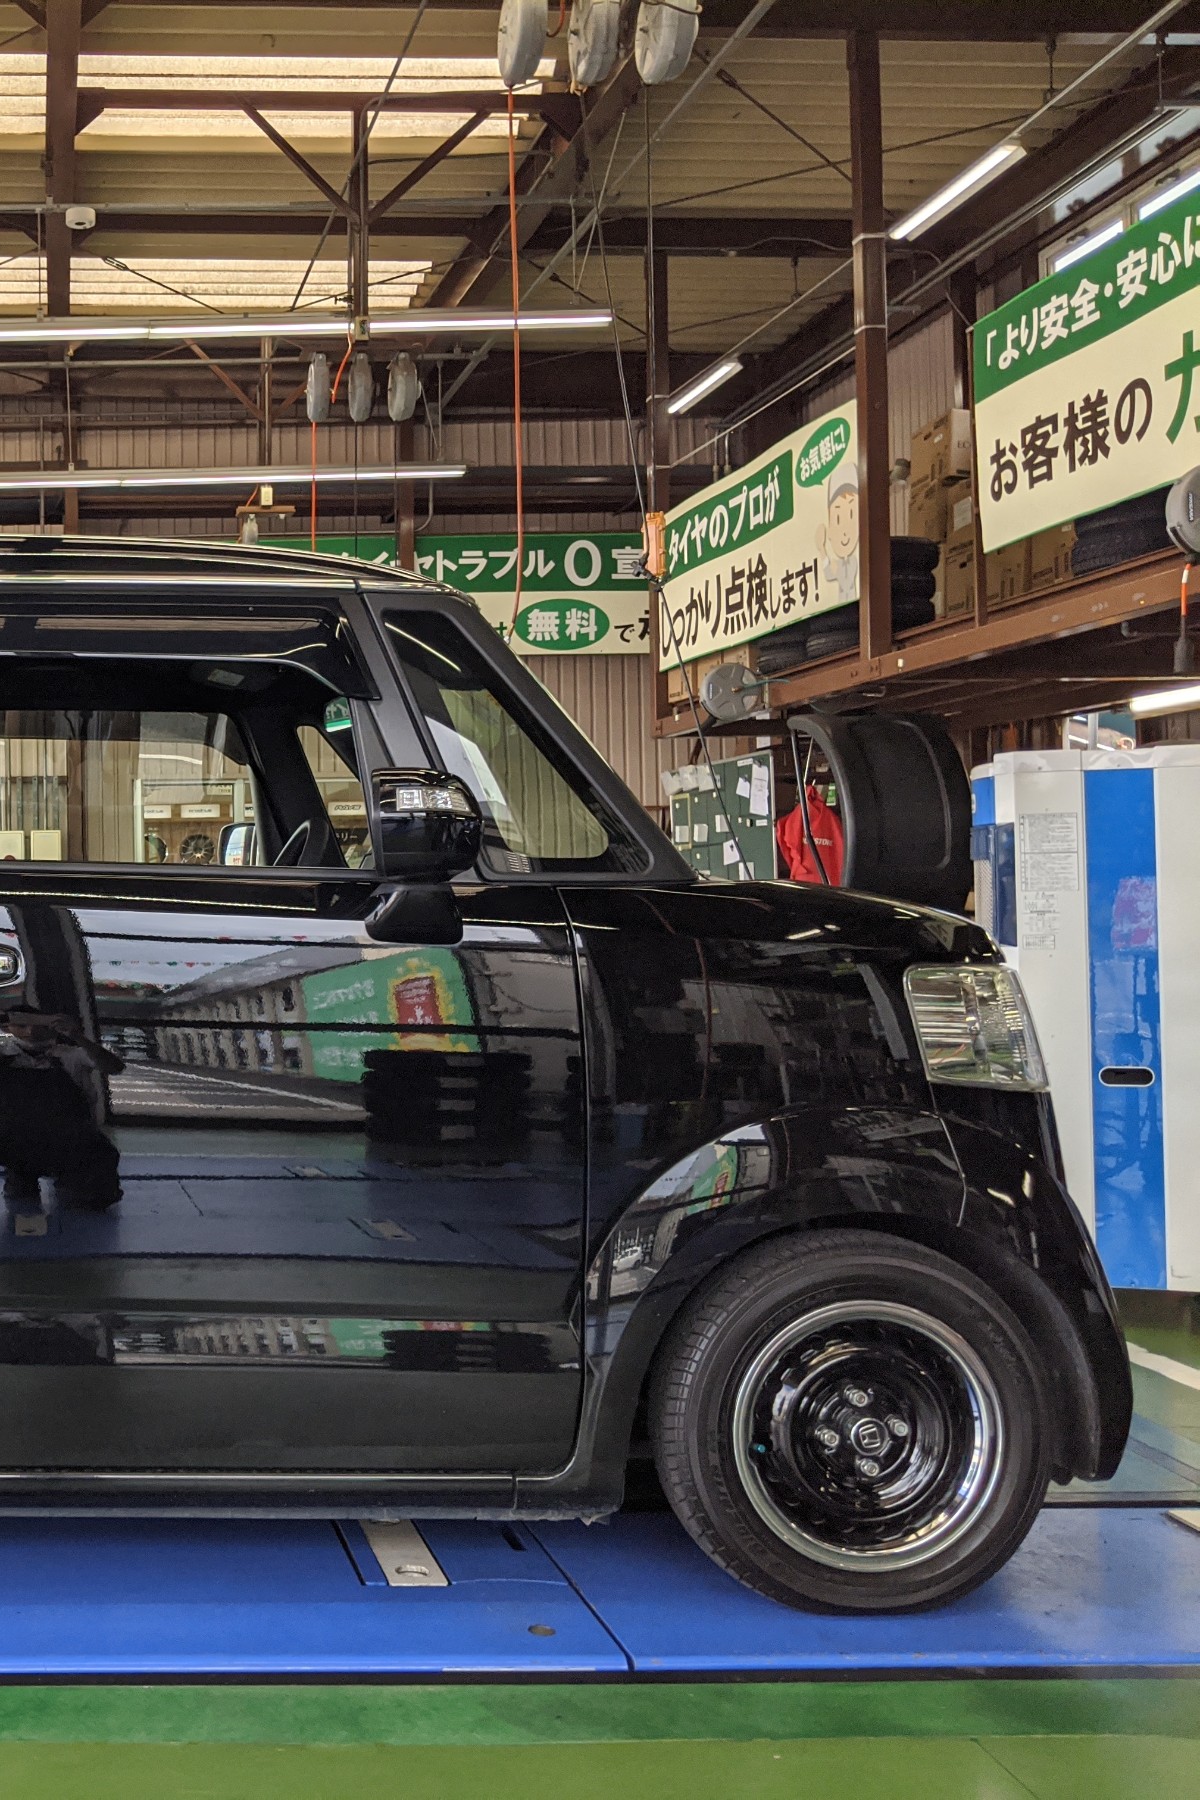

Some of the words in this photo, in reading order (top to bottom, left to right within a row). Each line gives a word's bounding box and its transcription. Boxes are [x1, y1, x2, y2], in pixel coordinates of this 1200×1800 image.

[669, 465, 781, 572] タイヤのプロが
[661, 553, 820, 658] しっかり点検します!
